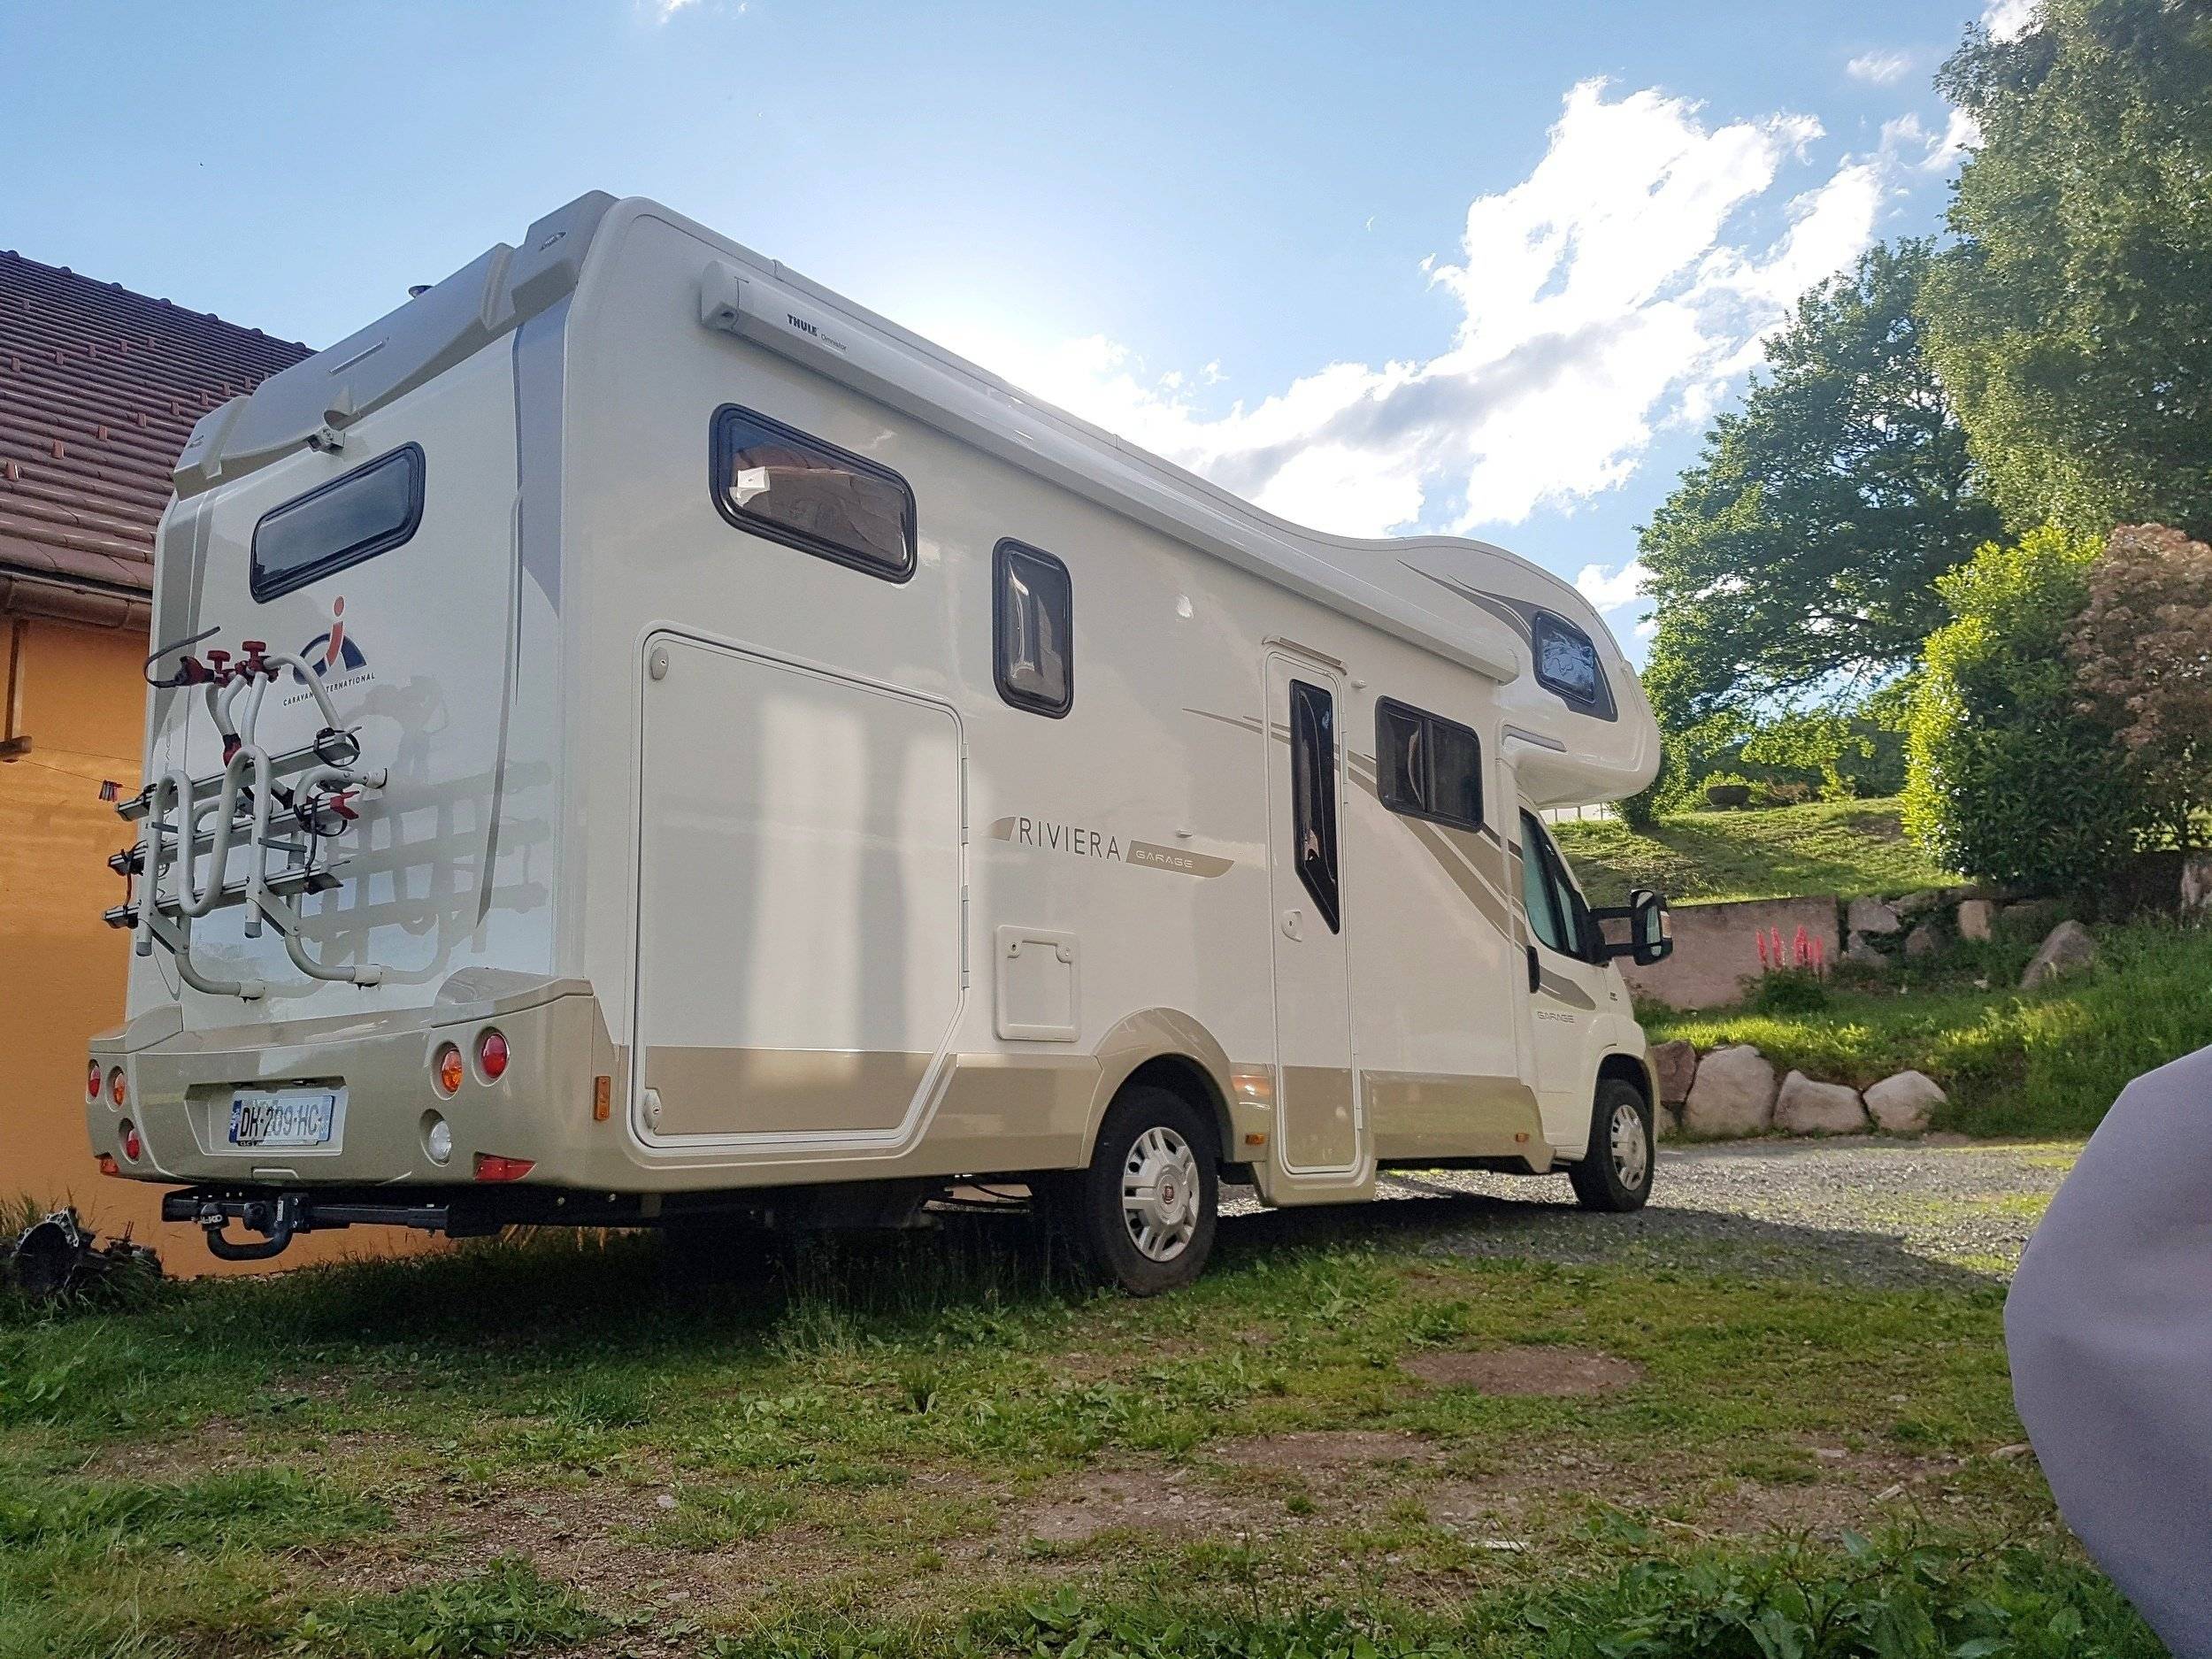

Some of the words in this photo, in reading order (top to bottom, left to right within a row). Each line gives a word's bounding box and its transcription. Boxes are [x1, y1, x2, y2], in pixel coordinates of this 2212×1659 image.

[787, 313, 818, 337] THULE
[283, 692, 314, 706] CARAVAN
[326, 672, 375, 693] TERNATIONAL
[1018, 817, 1121, 862] RIVIERA
[1135, 849, 1194, 869] GARAGE
[1537, 1011, 1575, 1024] GARAGE
